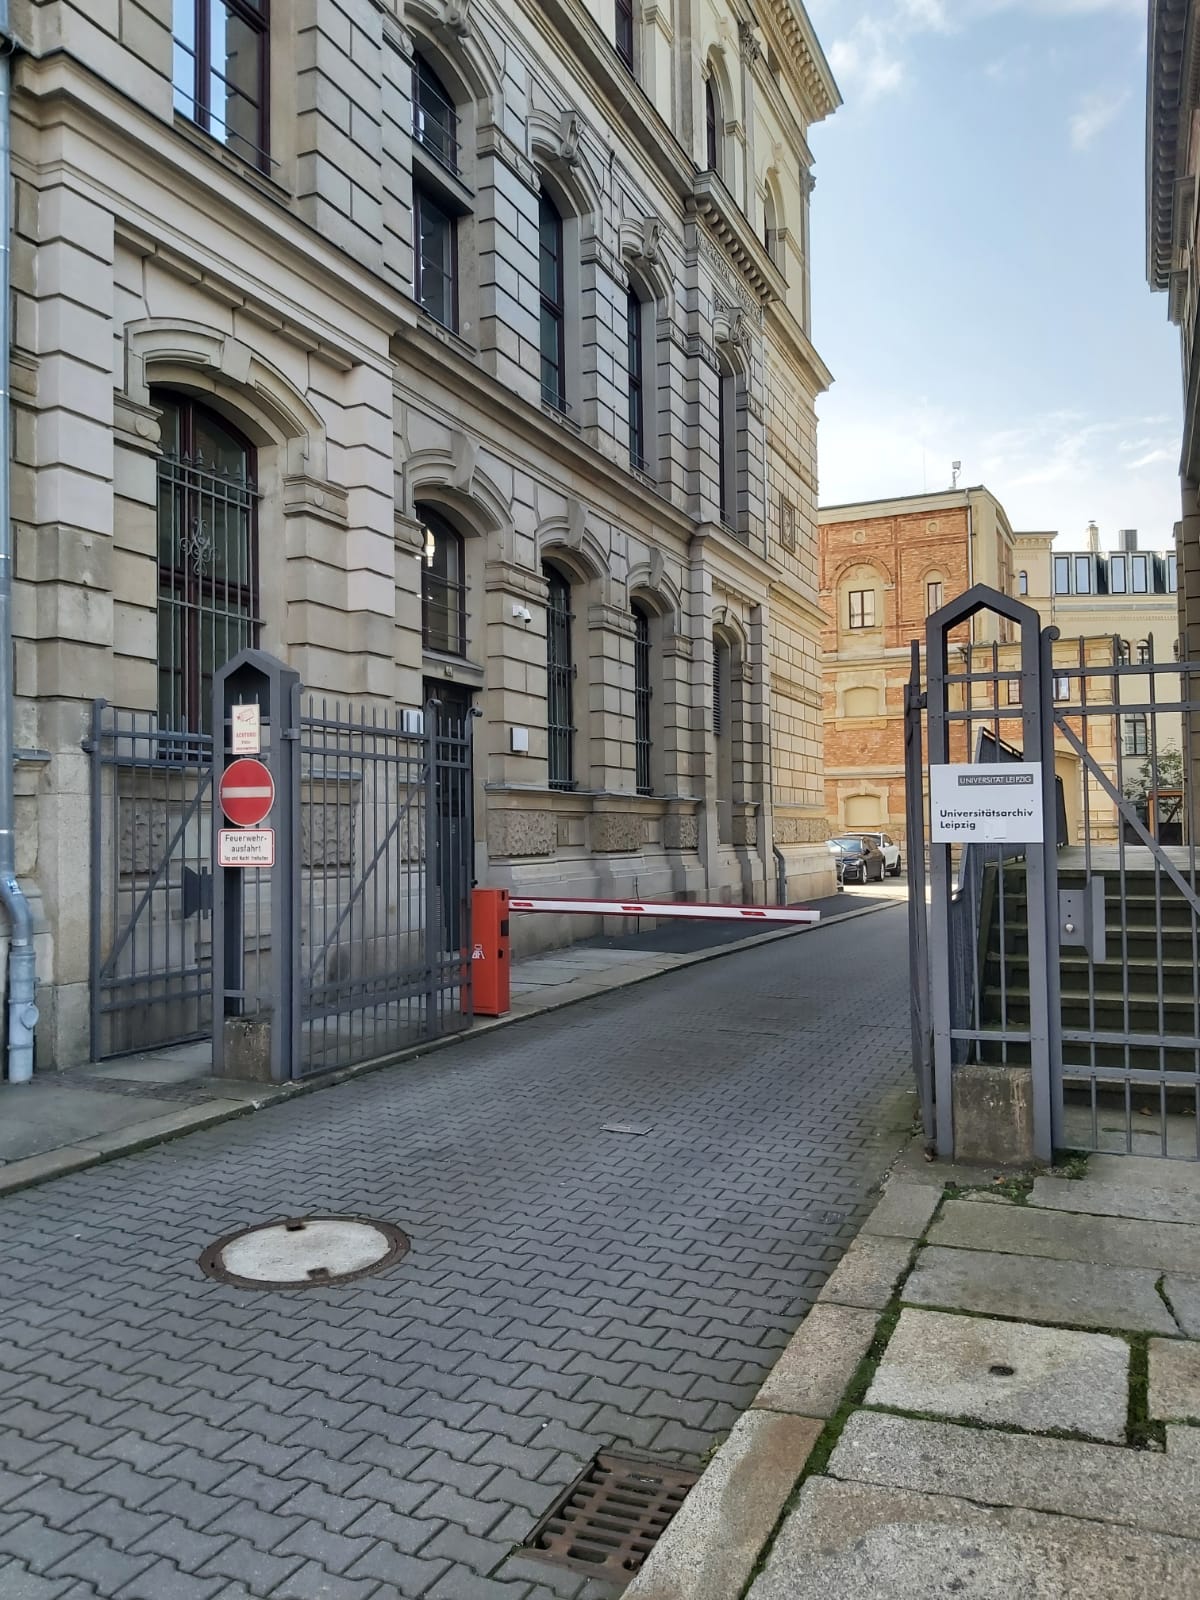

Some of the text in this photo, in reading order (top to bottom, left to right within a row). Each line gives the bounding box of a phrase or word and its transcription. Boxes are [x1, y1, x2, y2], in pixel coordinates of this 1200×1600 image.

[1005, 775, 1032, 783] LEIPZIG
[940, 808, 1034, 818] Universitätsarchiv
[940, 820, 976, 831] Leipzig
[225, 833, 268, 842] Feuerwehr-
[231, 844, 262, 853] ausfahrt
